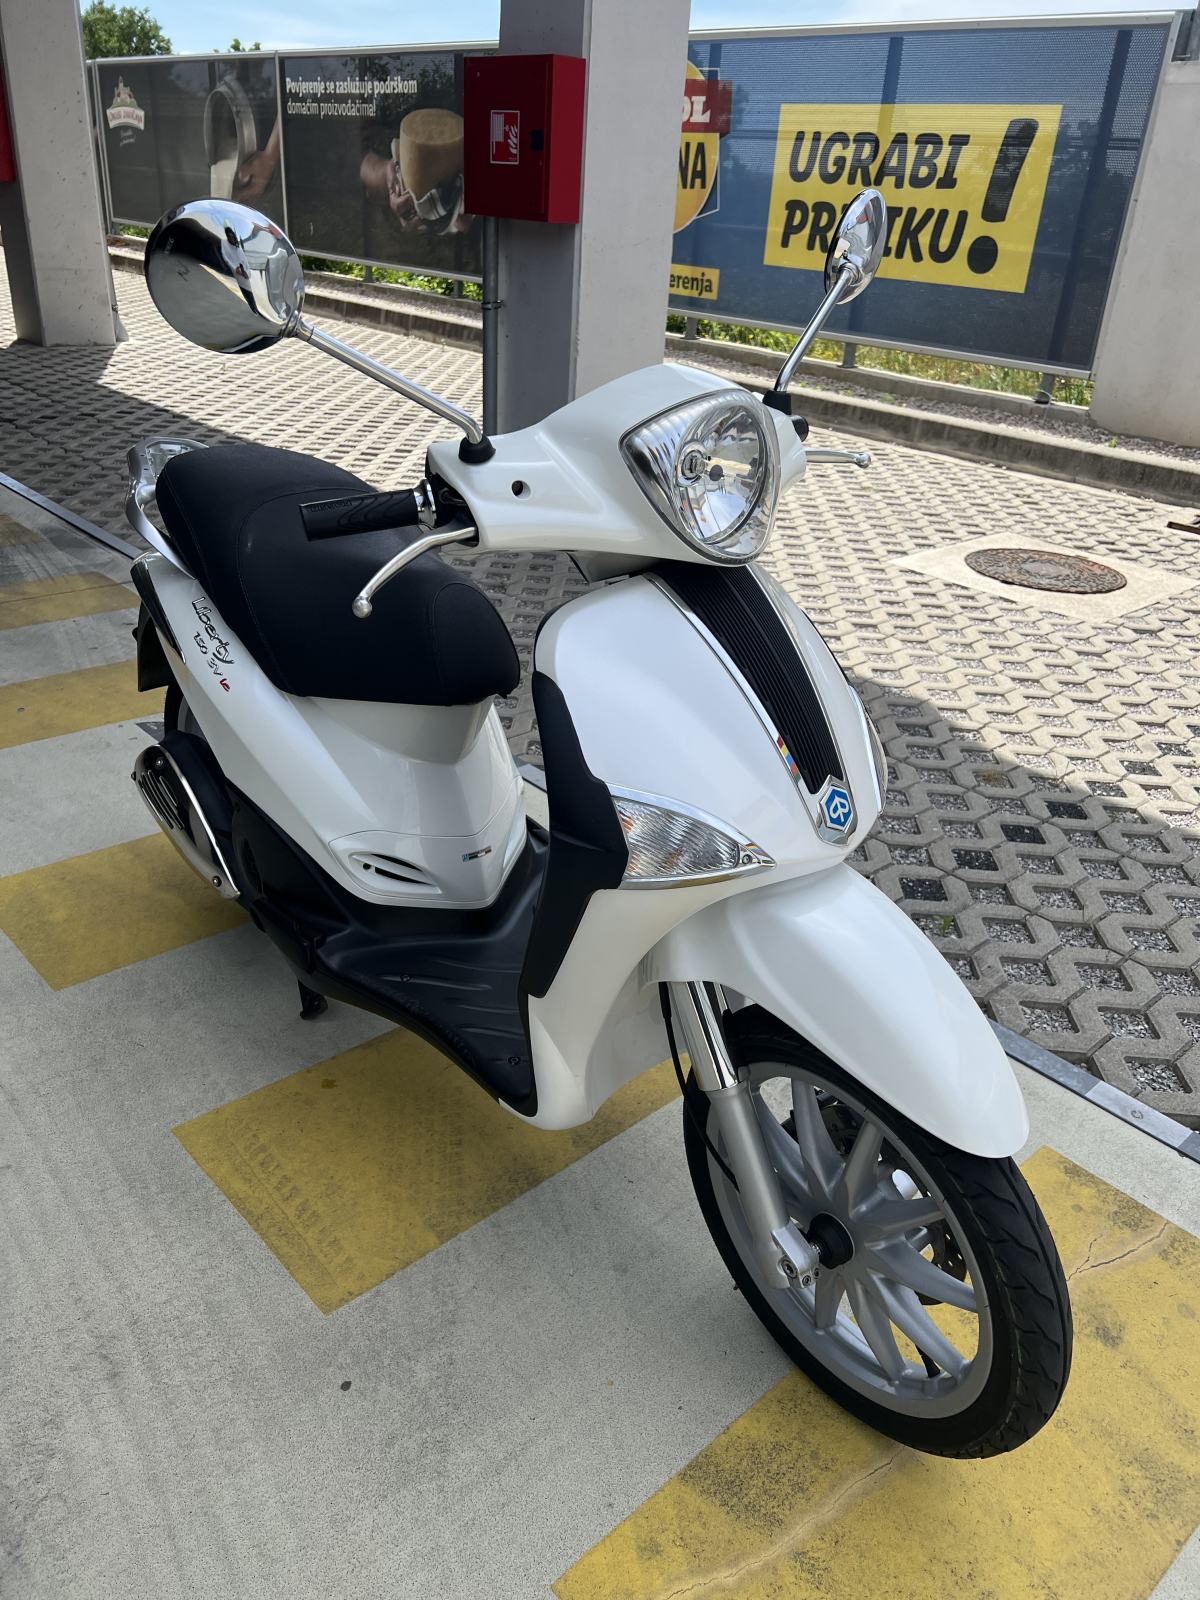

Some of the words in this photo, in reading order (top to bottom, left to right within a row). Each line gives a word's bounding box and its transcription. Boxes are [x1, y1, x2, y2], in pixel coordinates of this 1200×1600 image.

[286, 76, 325, 97] Povjerenje
[326, 81, 335, 93] se
[336, 76, 373, 97] zaslužuje
[373, 76, 417, 97] podrškom
[789, 131, 971, 189] UGRABI
[192, 597, 235, 664] Liberty
